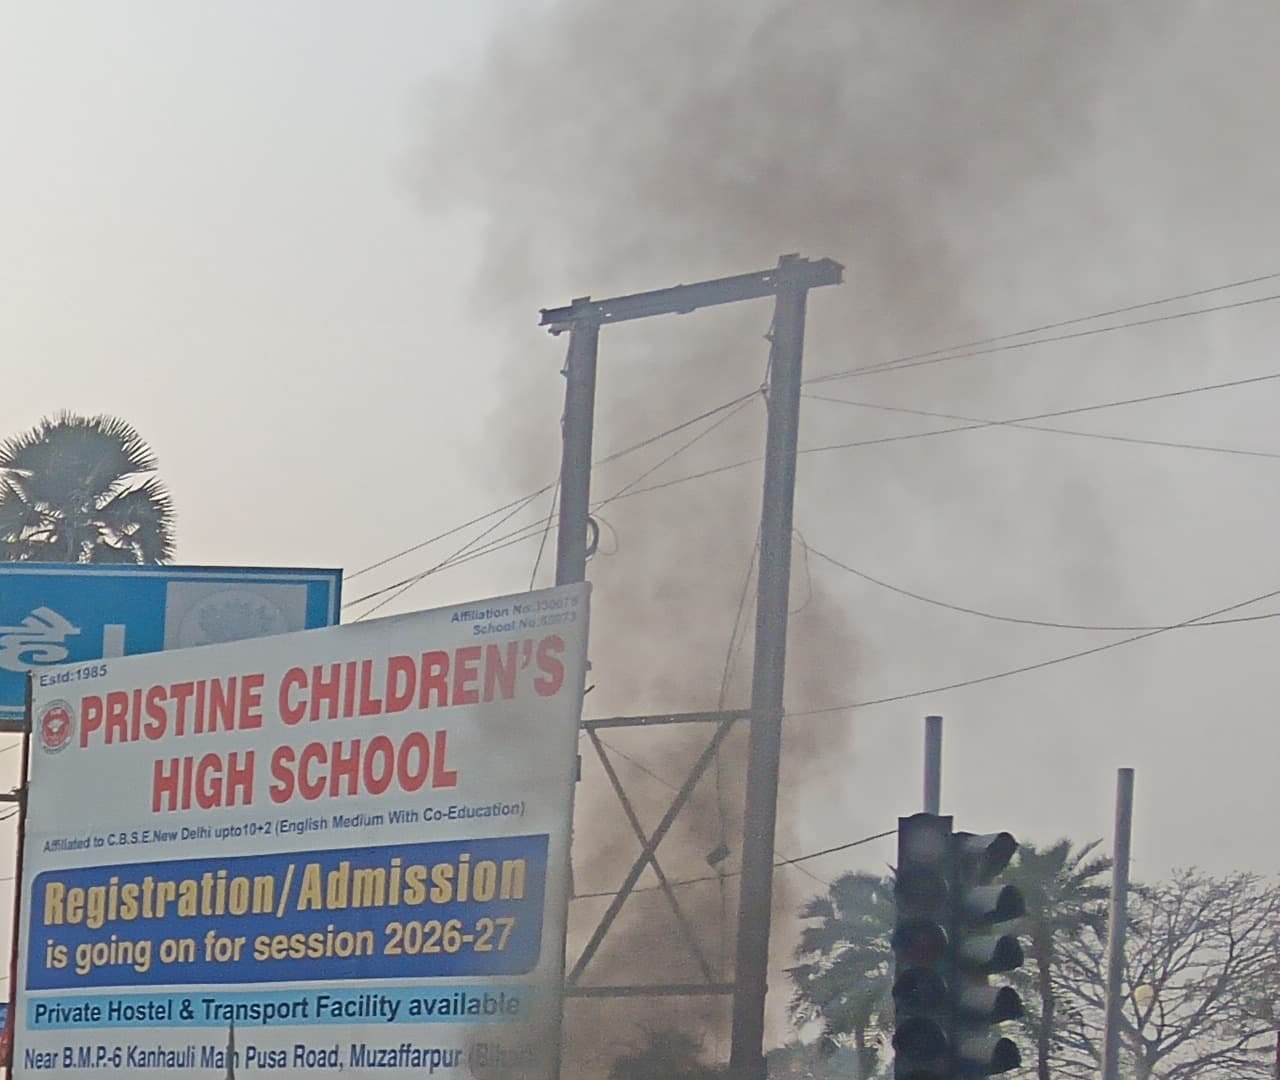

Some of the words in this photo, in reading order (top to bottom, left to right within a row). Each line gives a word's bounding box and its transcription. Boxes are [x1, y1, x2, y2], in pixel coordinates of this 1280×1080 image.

[451, 607, 509, 623] Affiliation
[473, 620, 515, 636] School
[80, 673, 265, 748] PRISTINE
[278, 634, 565, 726] CHILDREN'S
[151, 750, 256, 813] HIGH
[268, 730, 458, 803] SCHOOL
[43, 837, 91, 853] Affiliated
[93, 837, 104, 848] to
[181, 825, 212, 841] Delhi
[275, 816, 328, 837] (English
[332, 812, 384, 829] Medium
[388, 808, 419, 825] With
[423, 800, 526, 821] Co-Education)
[44, 852, 527, 929] Registration/Admission
[46, 939, 68, 968] is
[75, 934, 152, 975] going
[159, 937, 196, 963] on
[204, 929, 247, 962] for
[253, 924, 374, 961] session
[383, 917, 516, 955] 2026-27
[34, 1002, 101, 1024] Private
[108, 998, 172, 1021] Hostel
[179, 999, 194, 1020] &
[201, 996, 308, 1025] Transport
[316, 993, 401, 1022] Facility
[408, 992, 520, 1017] available
[24, 1048, 58, 1070] Near
[127, 1045, 196, 1068] Kanhauli
[200, 1045, 239, 1069] Man
[245, 1045, 287, 1069] Pusa
[293, 1044, 344, 1072] Road,
[350, 1044, 463, 1074] Muzaffarpur
